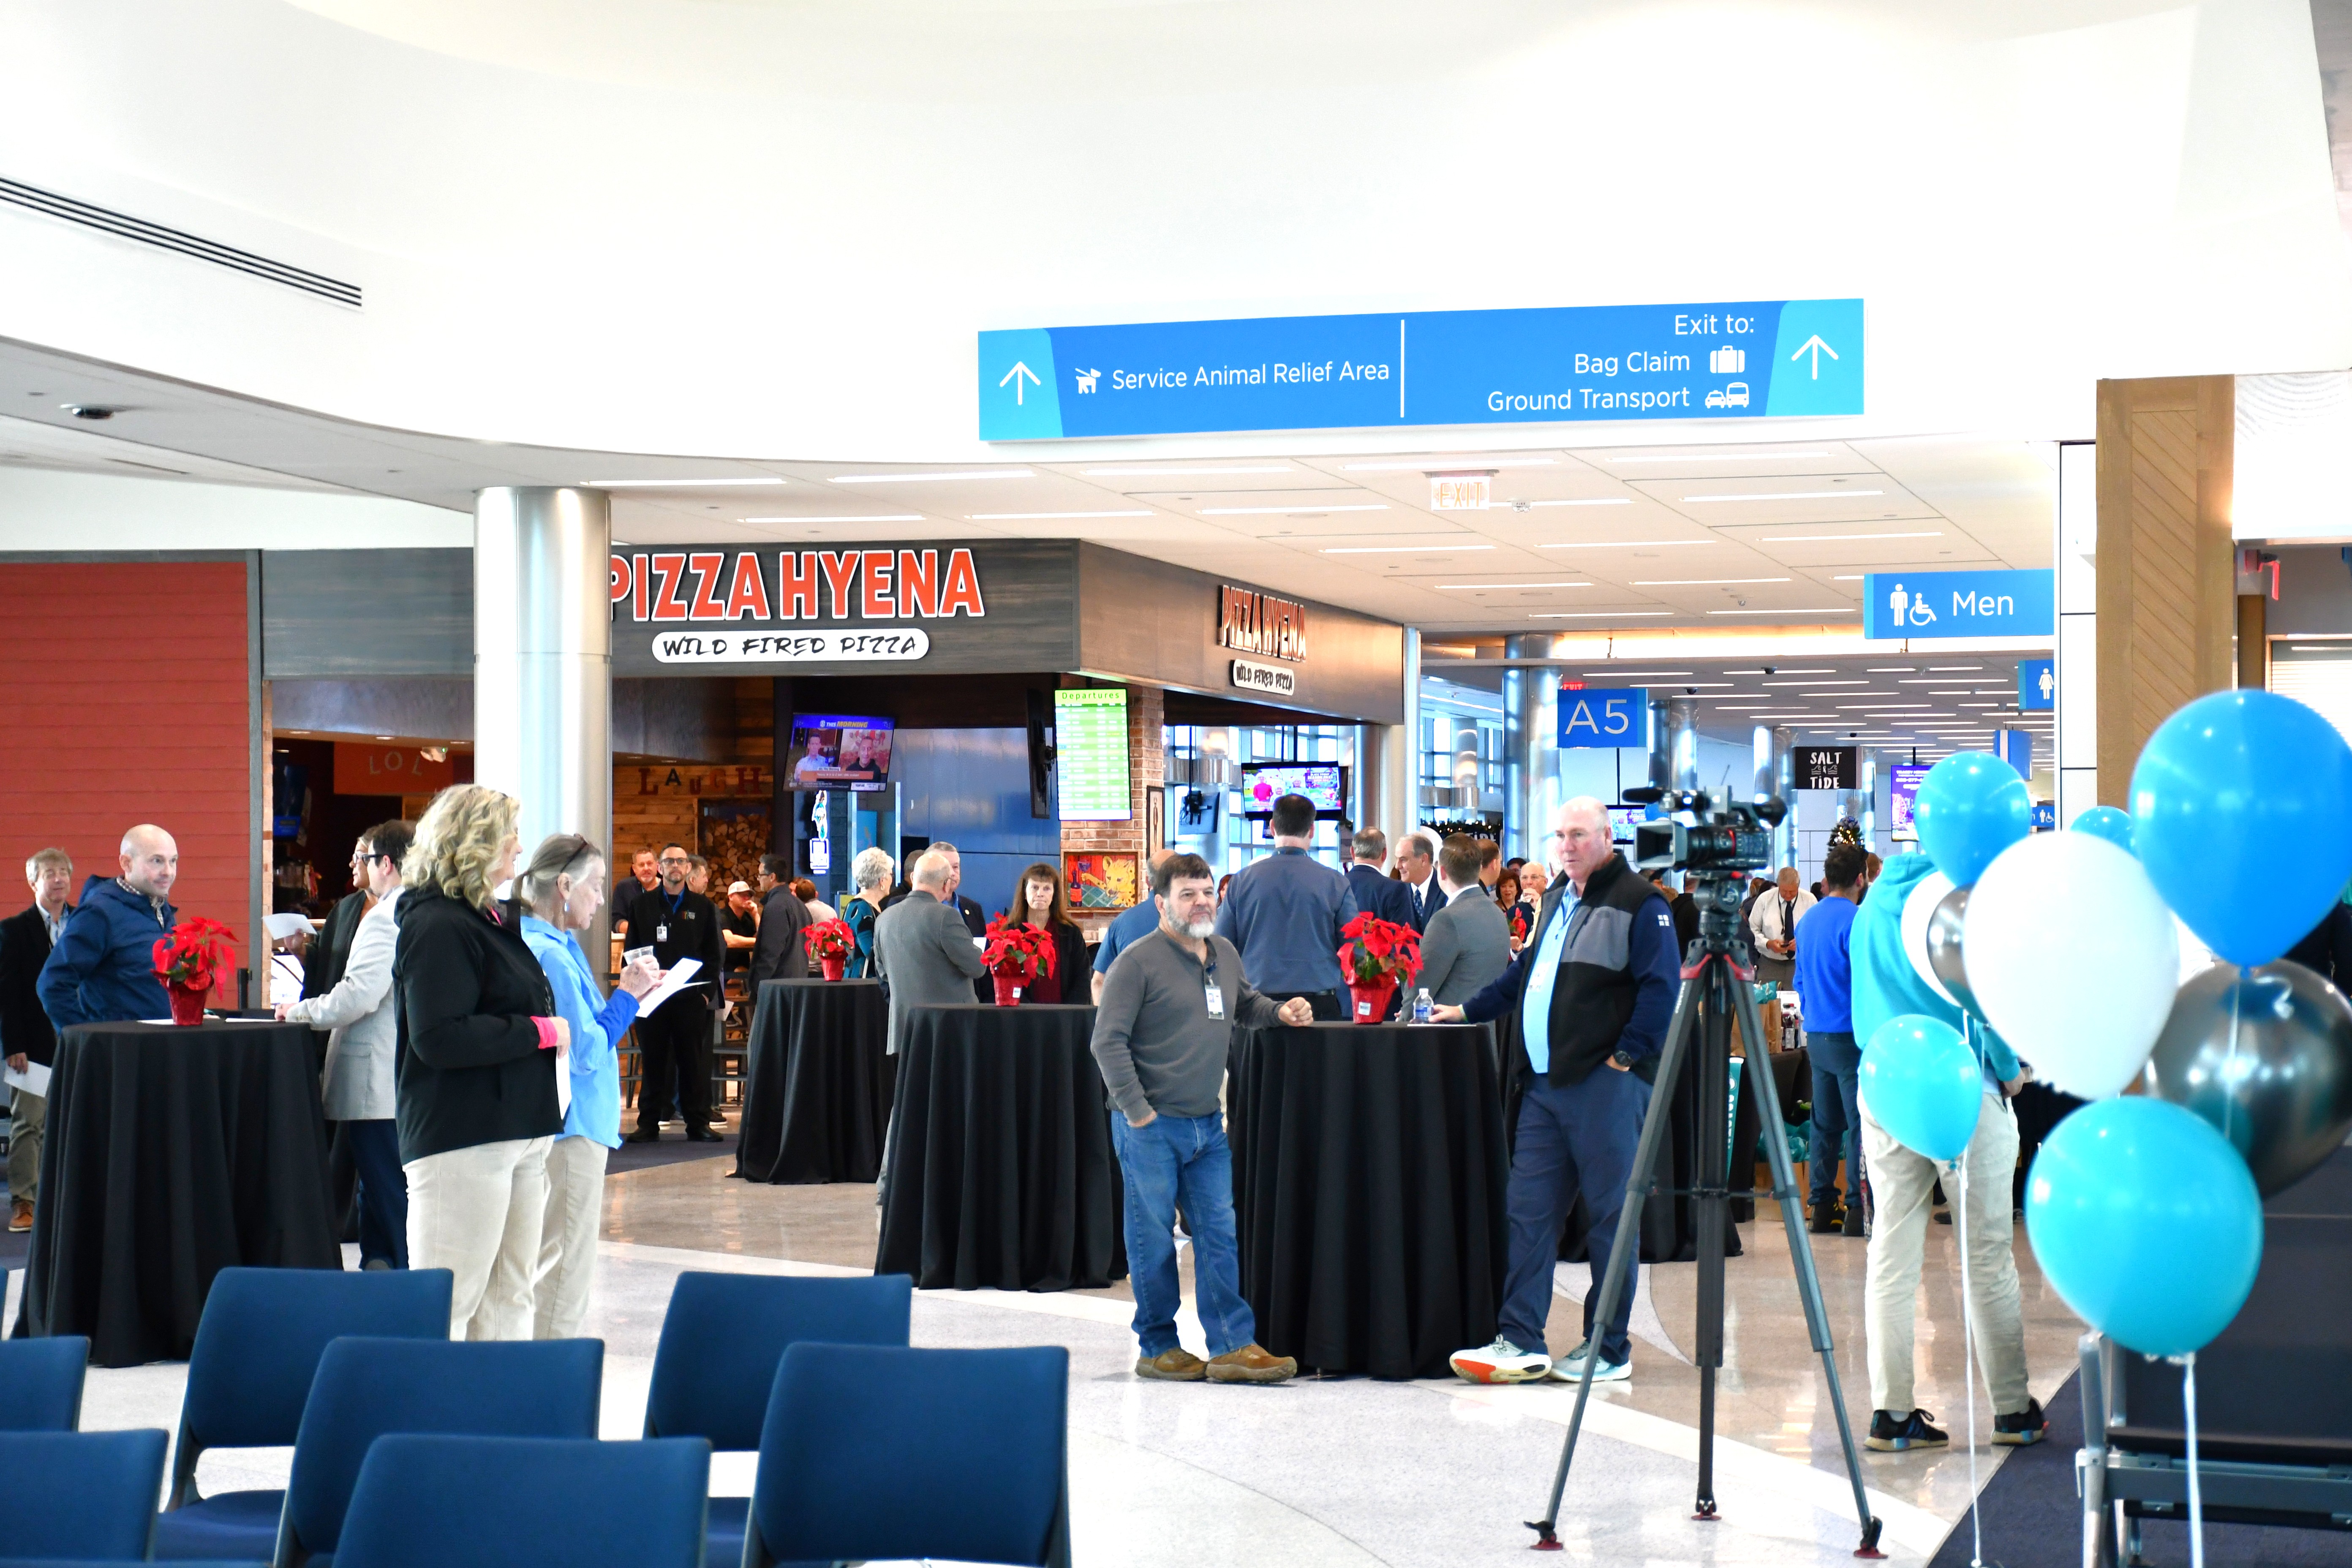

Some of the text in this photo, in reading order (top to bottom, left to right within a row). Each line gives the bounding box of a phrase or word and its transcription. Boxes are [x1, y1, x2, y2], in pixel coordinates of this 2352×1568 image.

[1675, 314, 1755, 335] Exit to:
[1112, 361, 1389, 389] Service Animal Relief Area
[1574, 351, 1690, 376] Bag Claim
[1487, 387, 1690, 411] Ground Transport
[1439, 482, 1483, 507] EXIT
[611, 548, 985, 622] PIZZA HYENA
[1953, 591, 2014, 616] Men
[1222, 585, 1306, 662] PIZZA HYENA
[663, 635, 917, 657] WILD FIRED PIZZA
[1236, 663, 1293, 691] WILD FIRED PIZZA
[1062, 692, 1119, 701] Departures
[1565, 699, 1629, 735] A5
[1810, 751, 1843, 765] SALT
